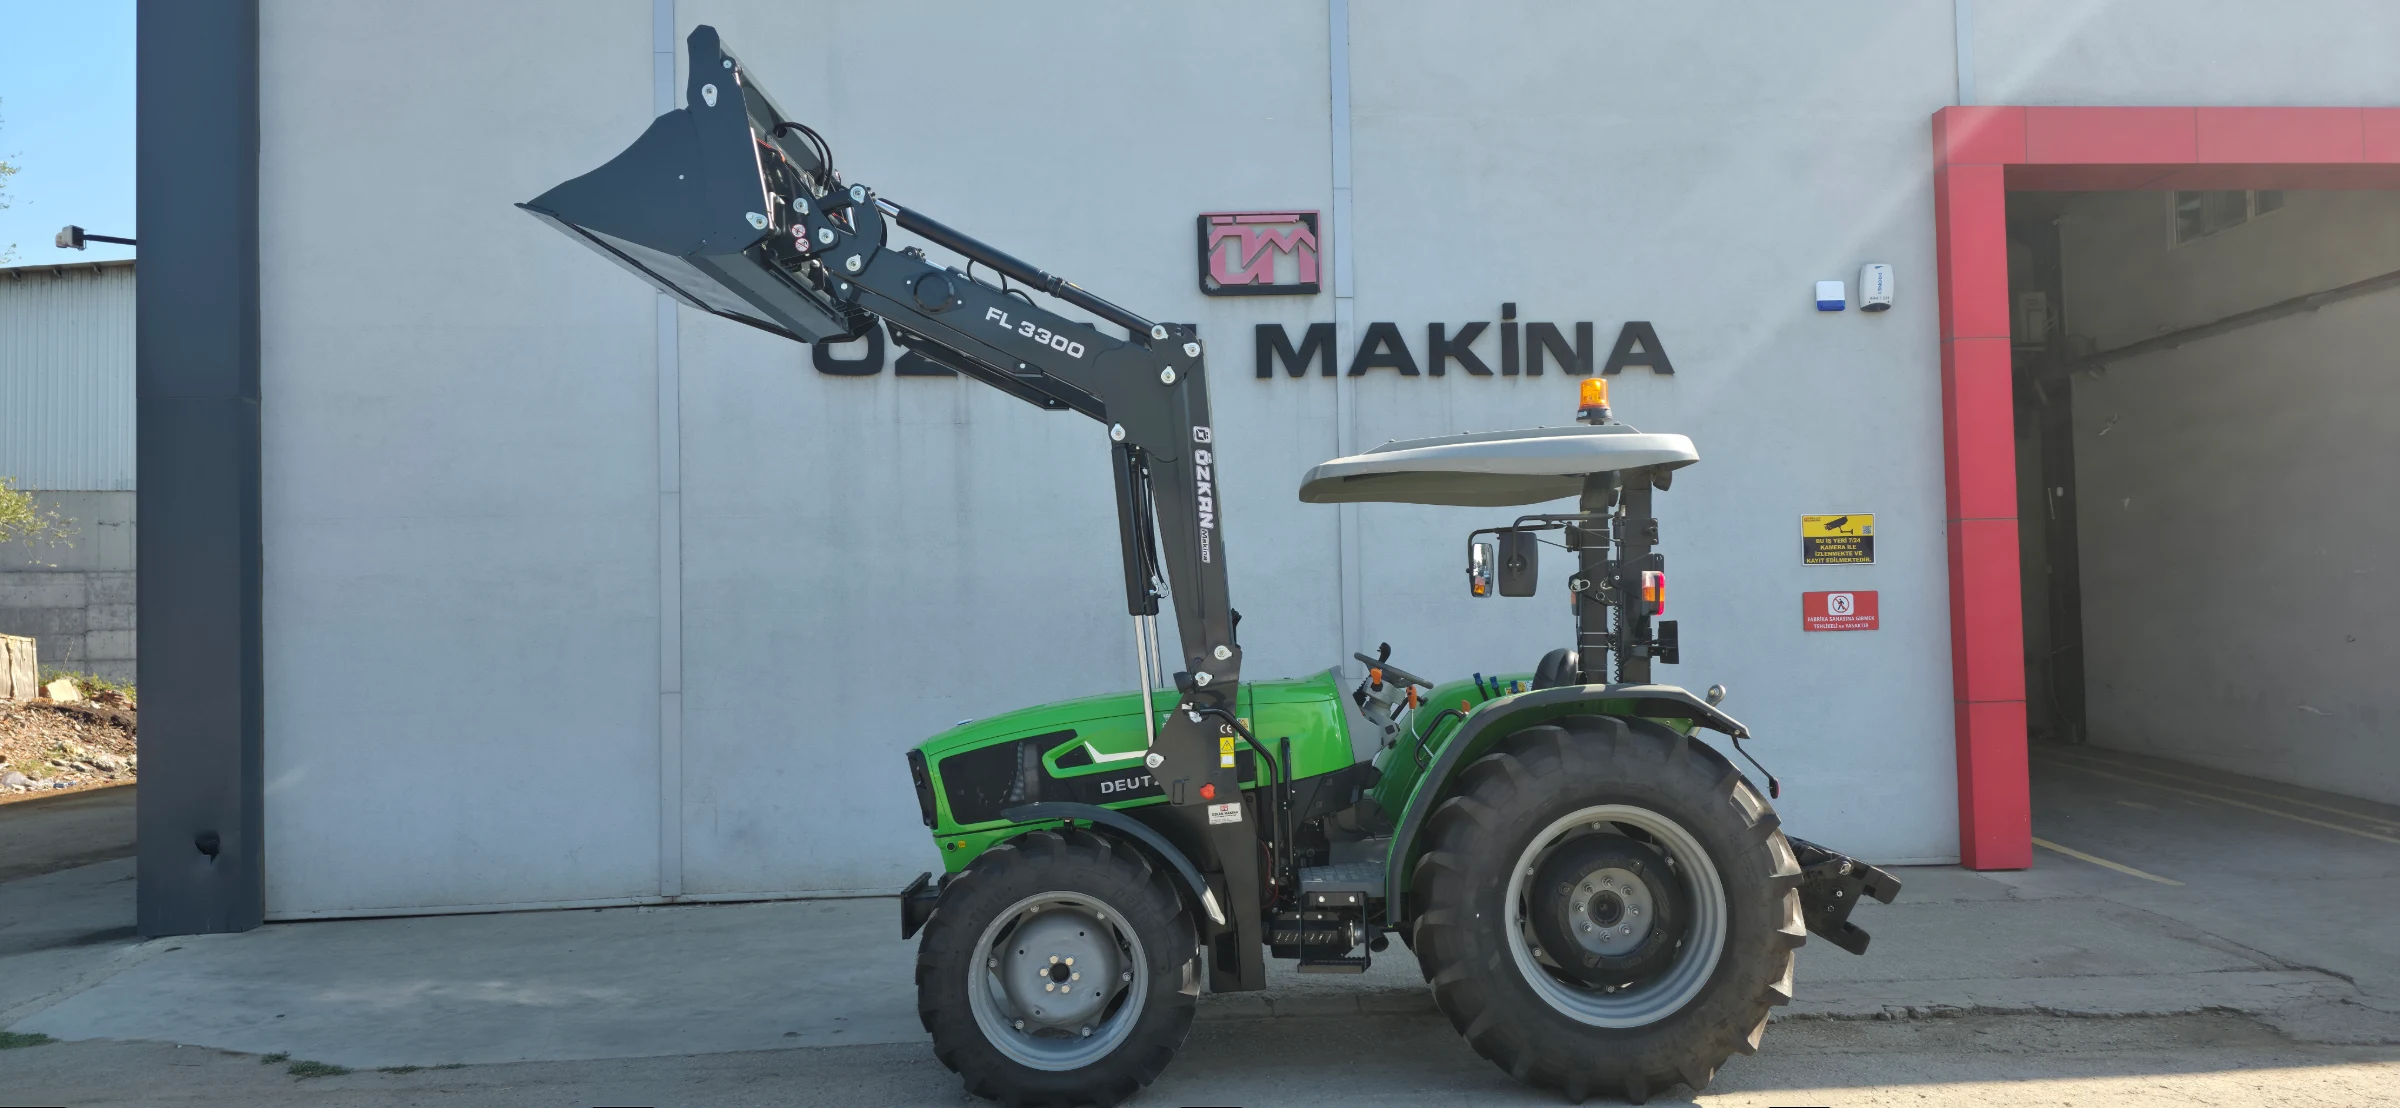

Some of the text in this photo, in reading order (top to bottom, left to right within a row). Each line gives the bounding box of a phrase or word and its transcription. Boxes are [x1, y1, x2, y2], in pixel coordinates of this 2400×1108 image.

[985, 306, 1086, 360] FL 3300
[1256, 302, 1676, 379] MAKİNA
[1195, 449, 1214, 529] ÖZKAN
[1201, 529, 1209, 562] Makina
[1219, 723, 1233, 734] CE
[1100, 775, 1161, 794] DEUT
